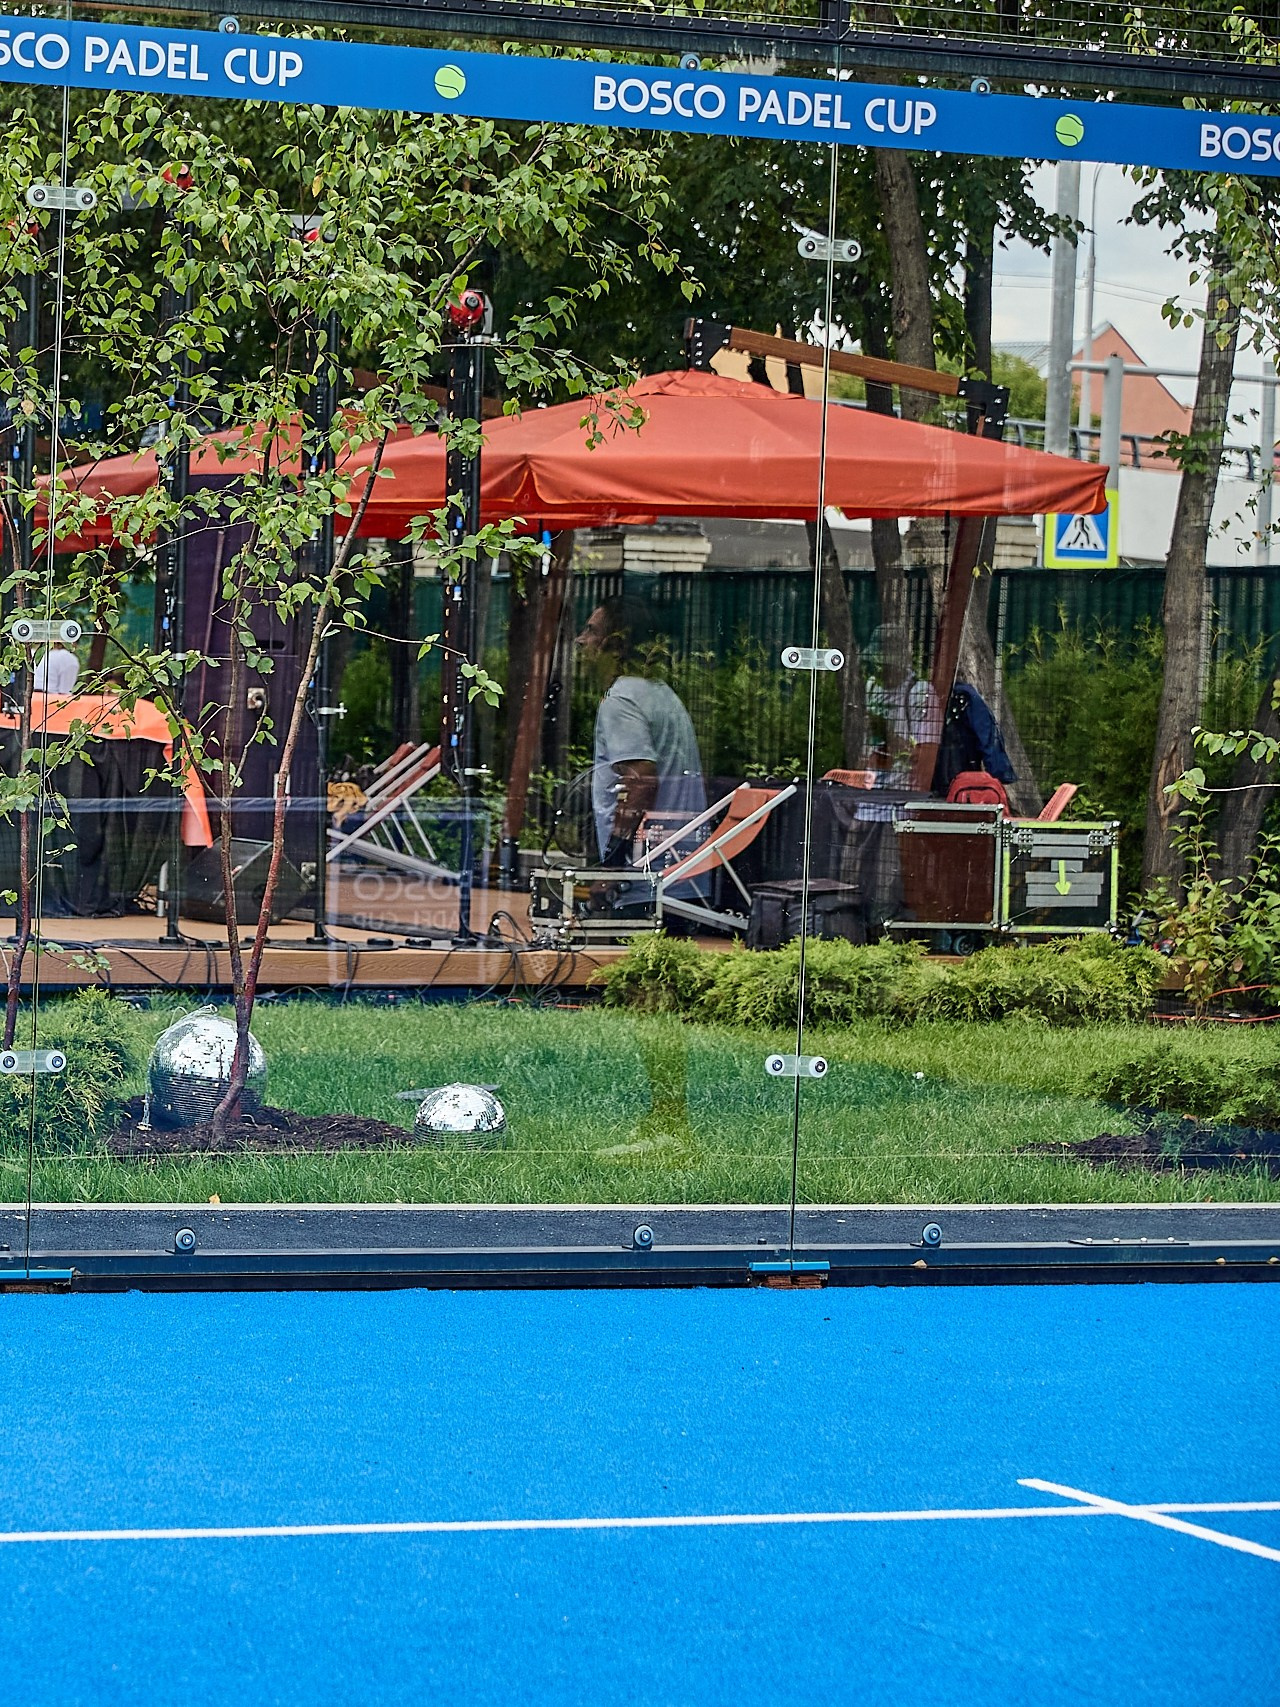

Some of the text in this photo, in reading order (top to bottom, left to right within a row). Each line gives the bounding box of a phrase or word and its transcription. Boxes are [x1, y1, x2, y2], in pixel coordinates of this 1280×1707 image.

[84, 36, 209, 81] PADEL
[223, 48, 304, 87] CUP
[593, 75, 937, 135] BOSCO PADEL CUP
